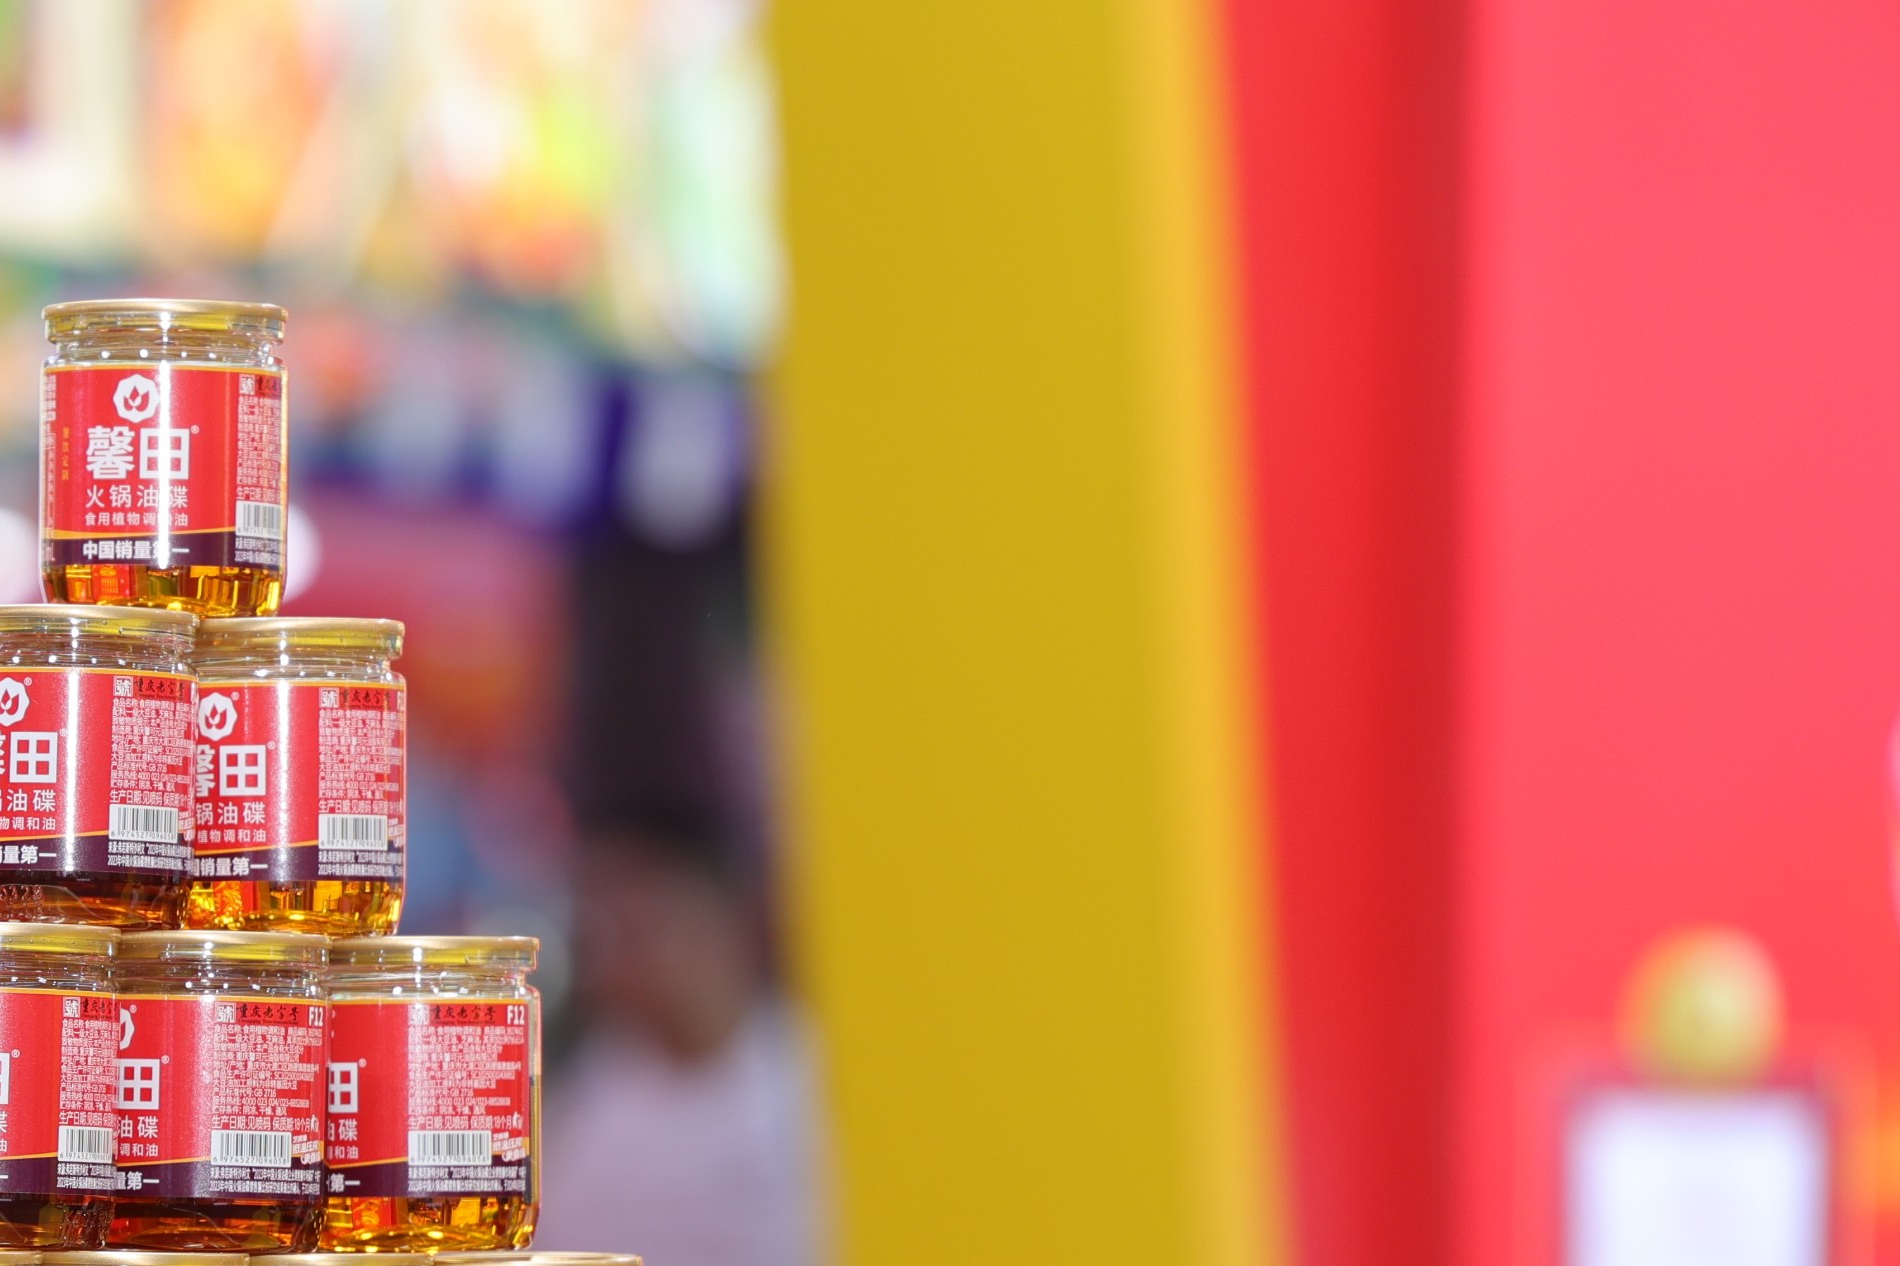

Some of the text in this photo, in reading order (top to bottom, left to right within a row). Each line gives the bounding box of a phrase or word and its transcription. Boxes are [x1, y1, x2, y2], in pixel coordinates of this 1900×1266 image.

[86, 426, 190, 479] 馨田
[85, 512, 188, 526] 食用植物调油
[309, 1007, 323, 1026] F12
[507, 1005, 524, 1025] F12
[326, 1174, 360, 1193] 第一
